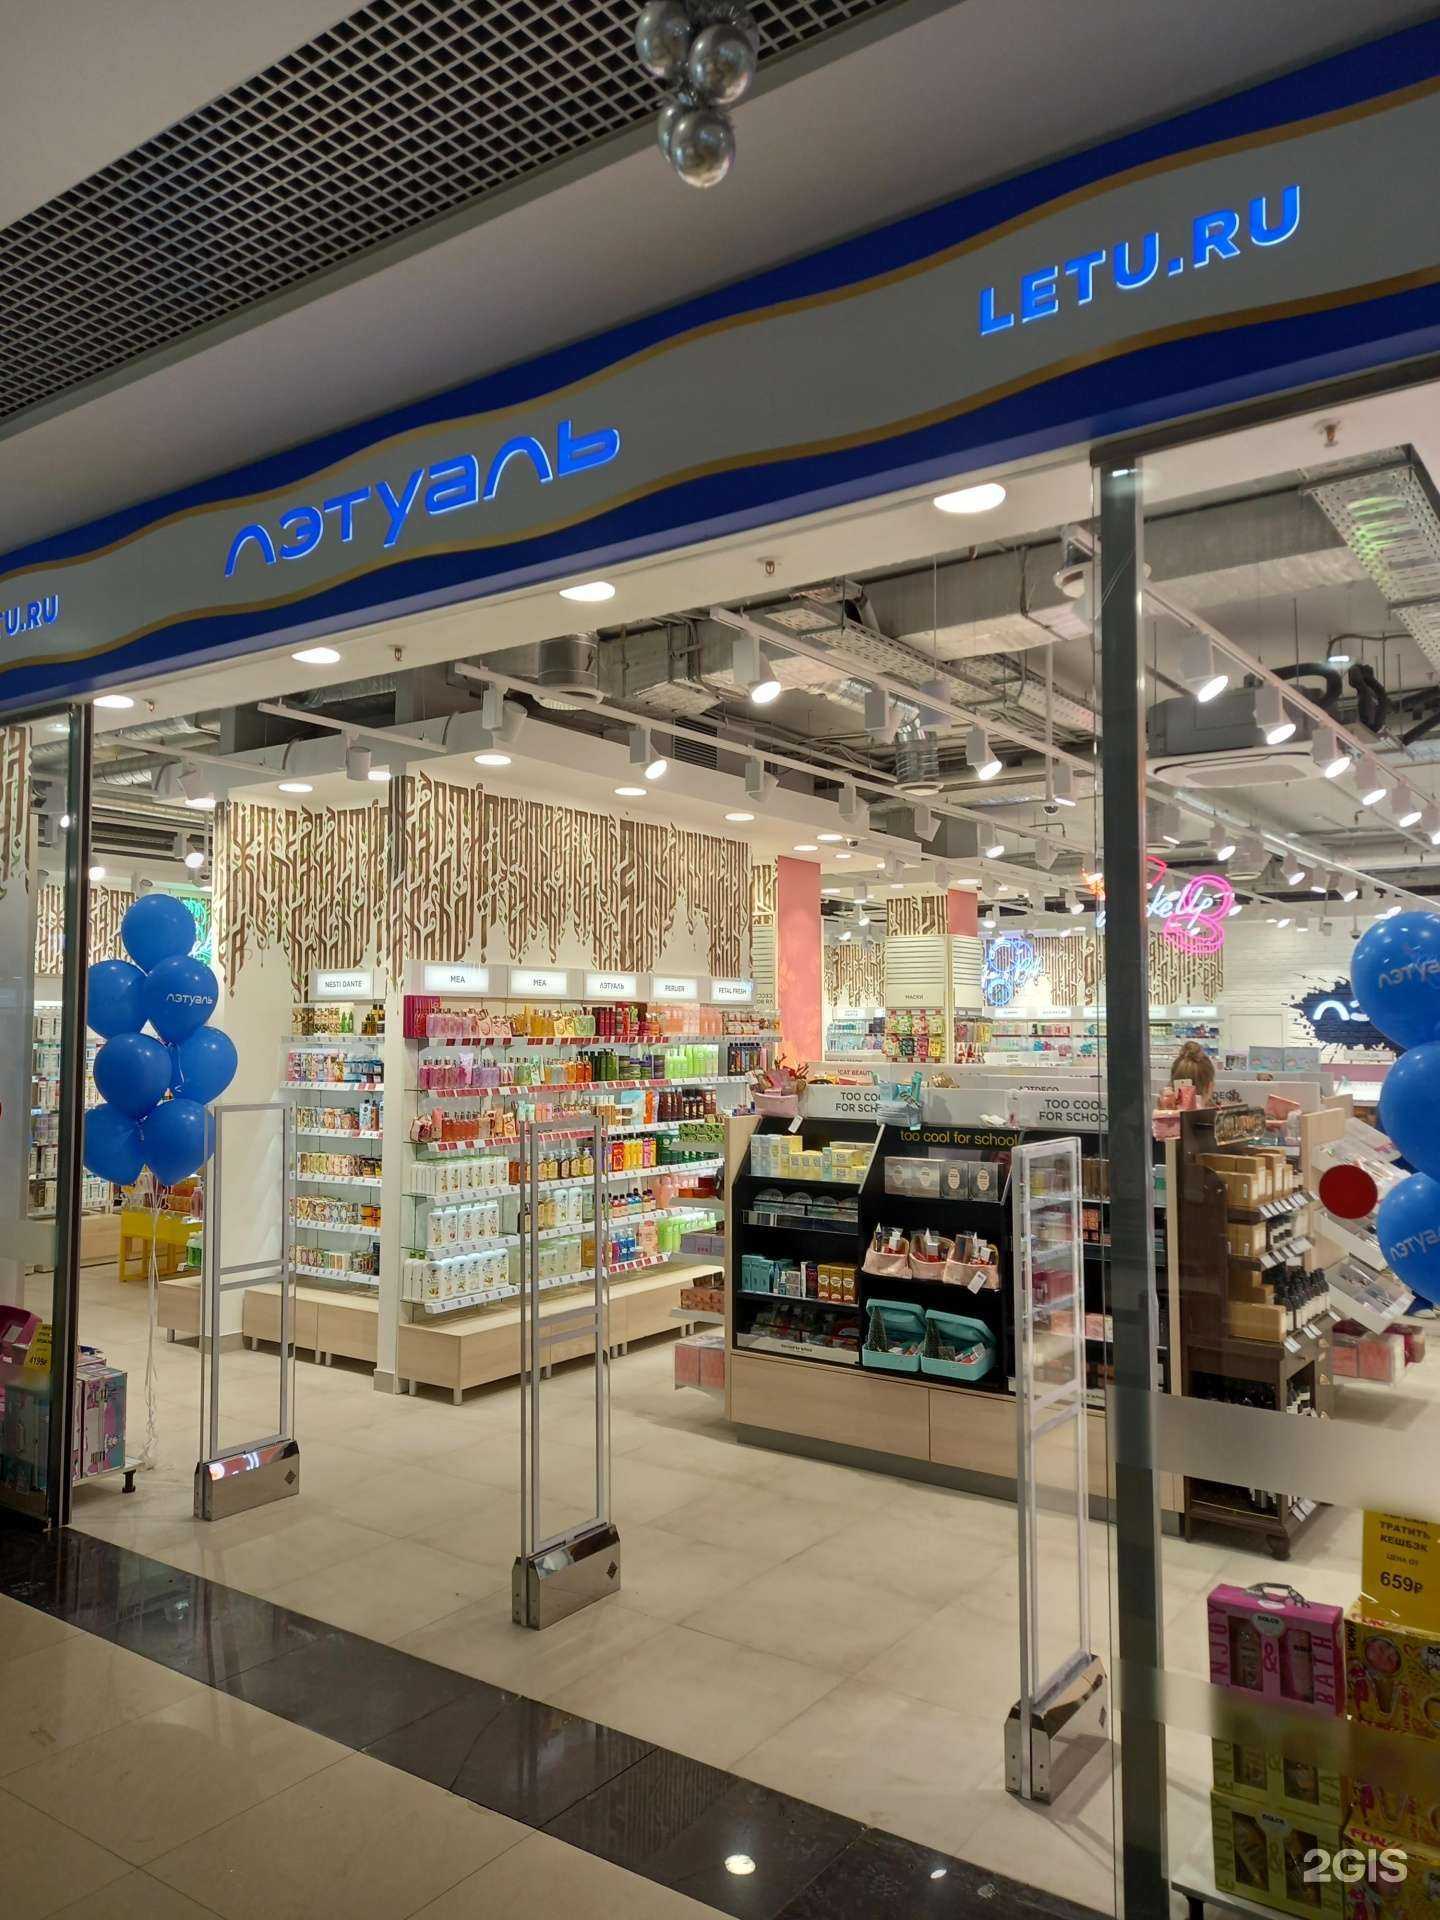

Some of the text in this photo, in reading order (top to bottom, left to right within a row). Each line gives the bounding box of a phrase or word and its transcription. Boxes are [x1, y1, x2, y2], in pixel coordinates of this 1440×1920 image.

[979, 184, 1300, 336] LETU.RU
[841, 1092, 861, 1101] TOO
[1045, 1099, 1070, 1109] TOO
[836, 1103, 856, 1112] FOR
[1040, 1111, 1109, 1123] FOR SCHOO
[900, 1129, 1018, 1147] too cool for school
[1380, 1521, 1431, 1540] ТРАТИТЬ
[1380, 1533, 1429, 1553] КЕШБЭК
[1208, 1603, 1231, 1688] NJOY
